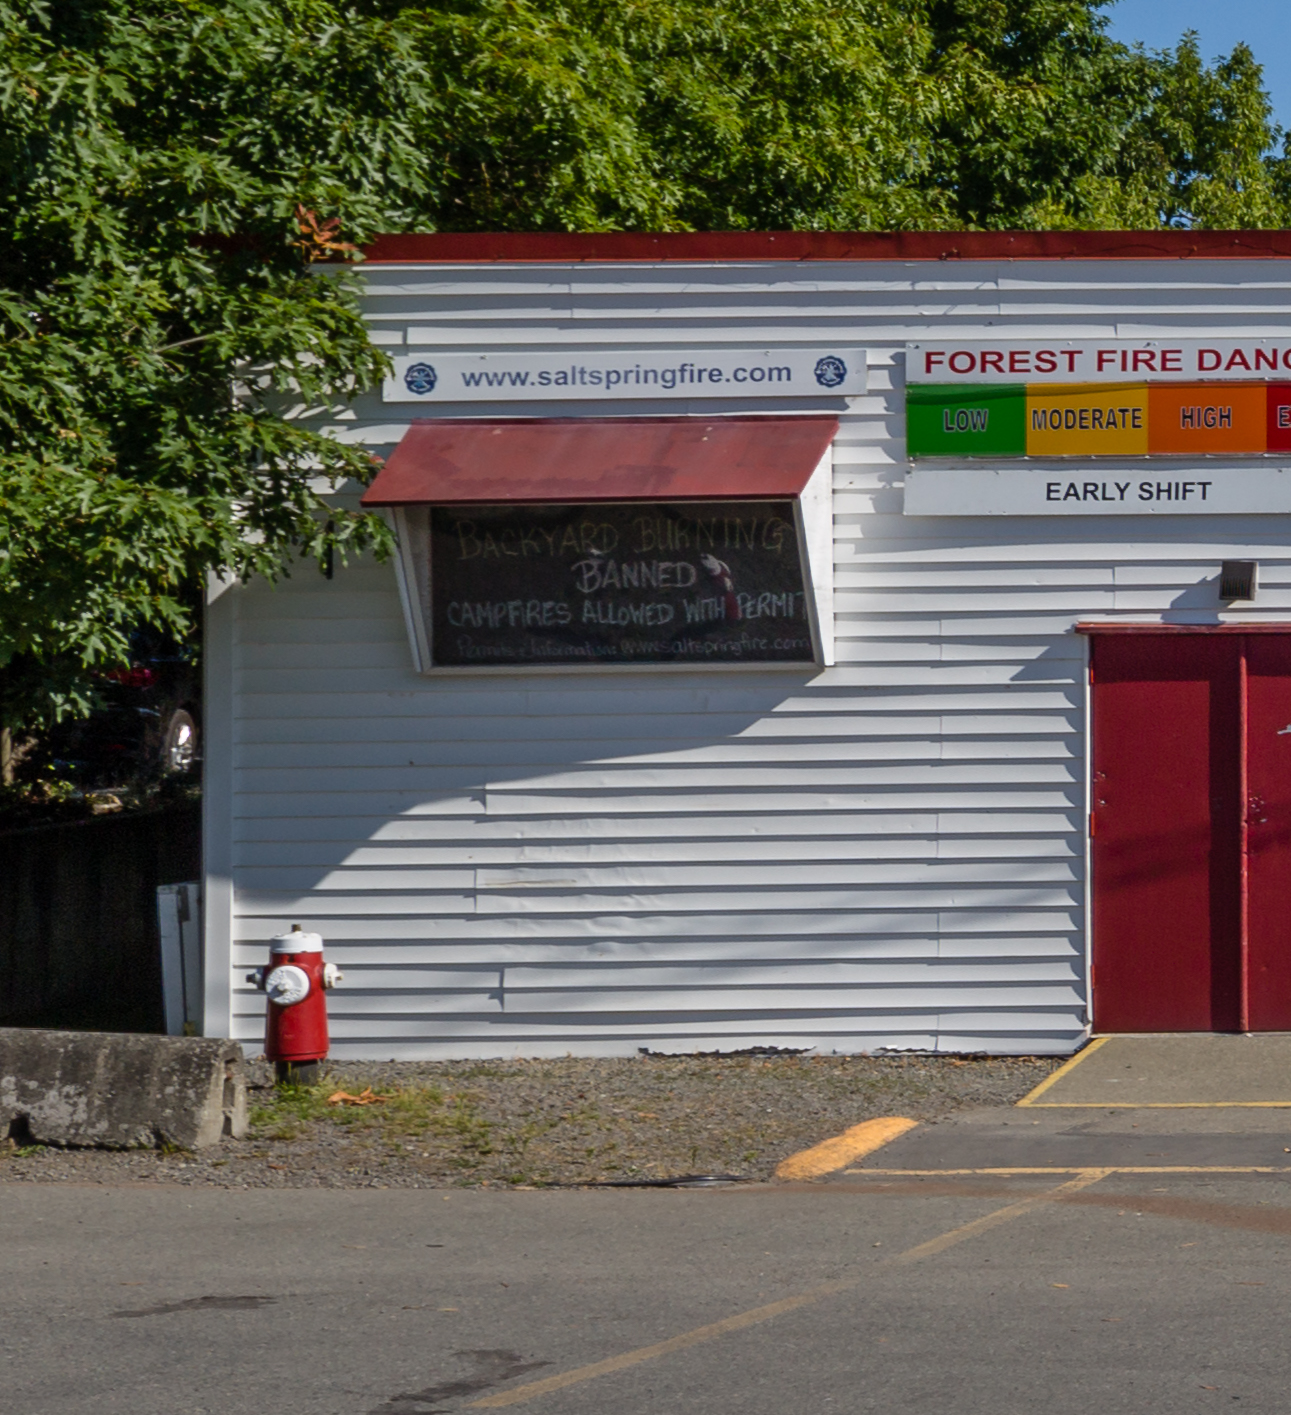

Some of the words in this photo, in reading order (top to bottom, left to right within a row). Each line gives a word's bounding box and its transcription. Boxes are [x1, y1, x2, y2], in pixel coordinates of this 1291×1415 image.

[924, 349, 1083, 374] FOREST
[1096, 348, 1184, 373] FIRE
[461, 363, 792, 390] www.saltspringfire.com
[943, 407, 989, 432] LOW
[1031, 406, 1143, 431] MODERATE
[1180, 405, 1233, 429] HIGH
[1046, 481, 1132, 502] EARLY
[1138, 480, 1212, 501] SHIFT
[457, 520, 619, 560] BACKYARD
[633, 516, 786, 554] BURNING
[571, 558, 697, 593] BANNED
[447, 600, 572, 628] CAMPFIRES
[582, 599, 674, 626] ALLOWED
[683, 597, 725, 624] WITH
